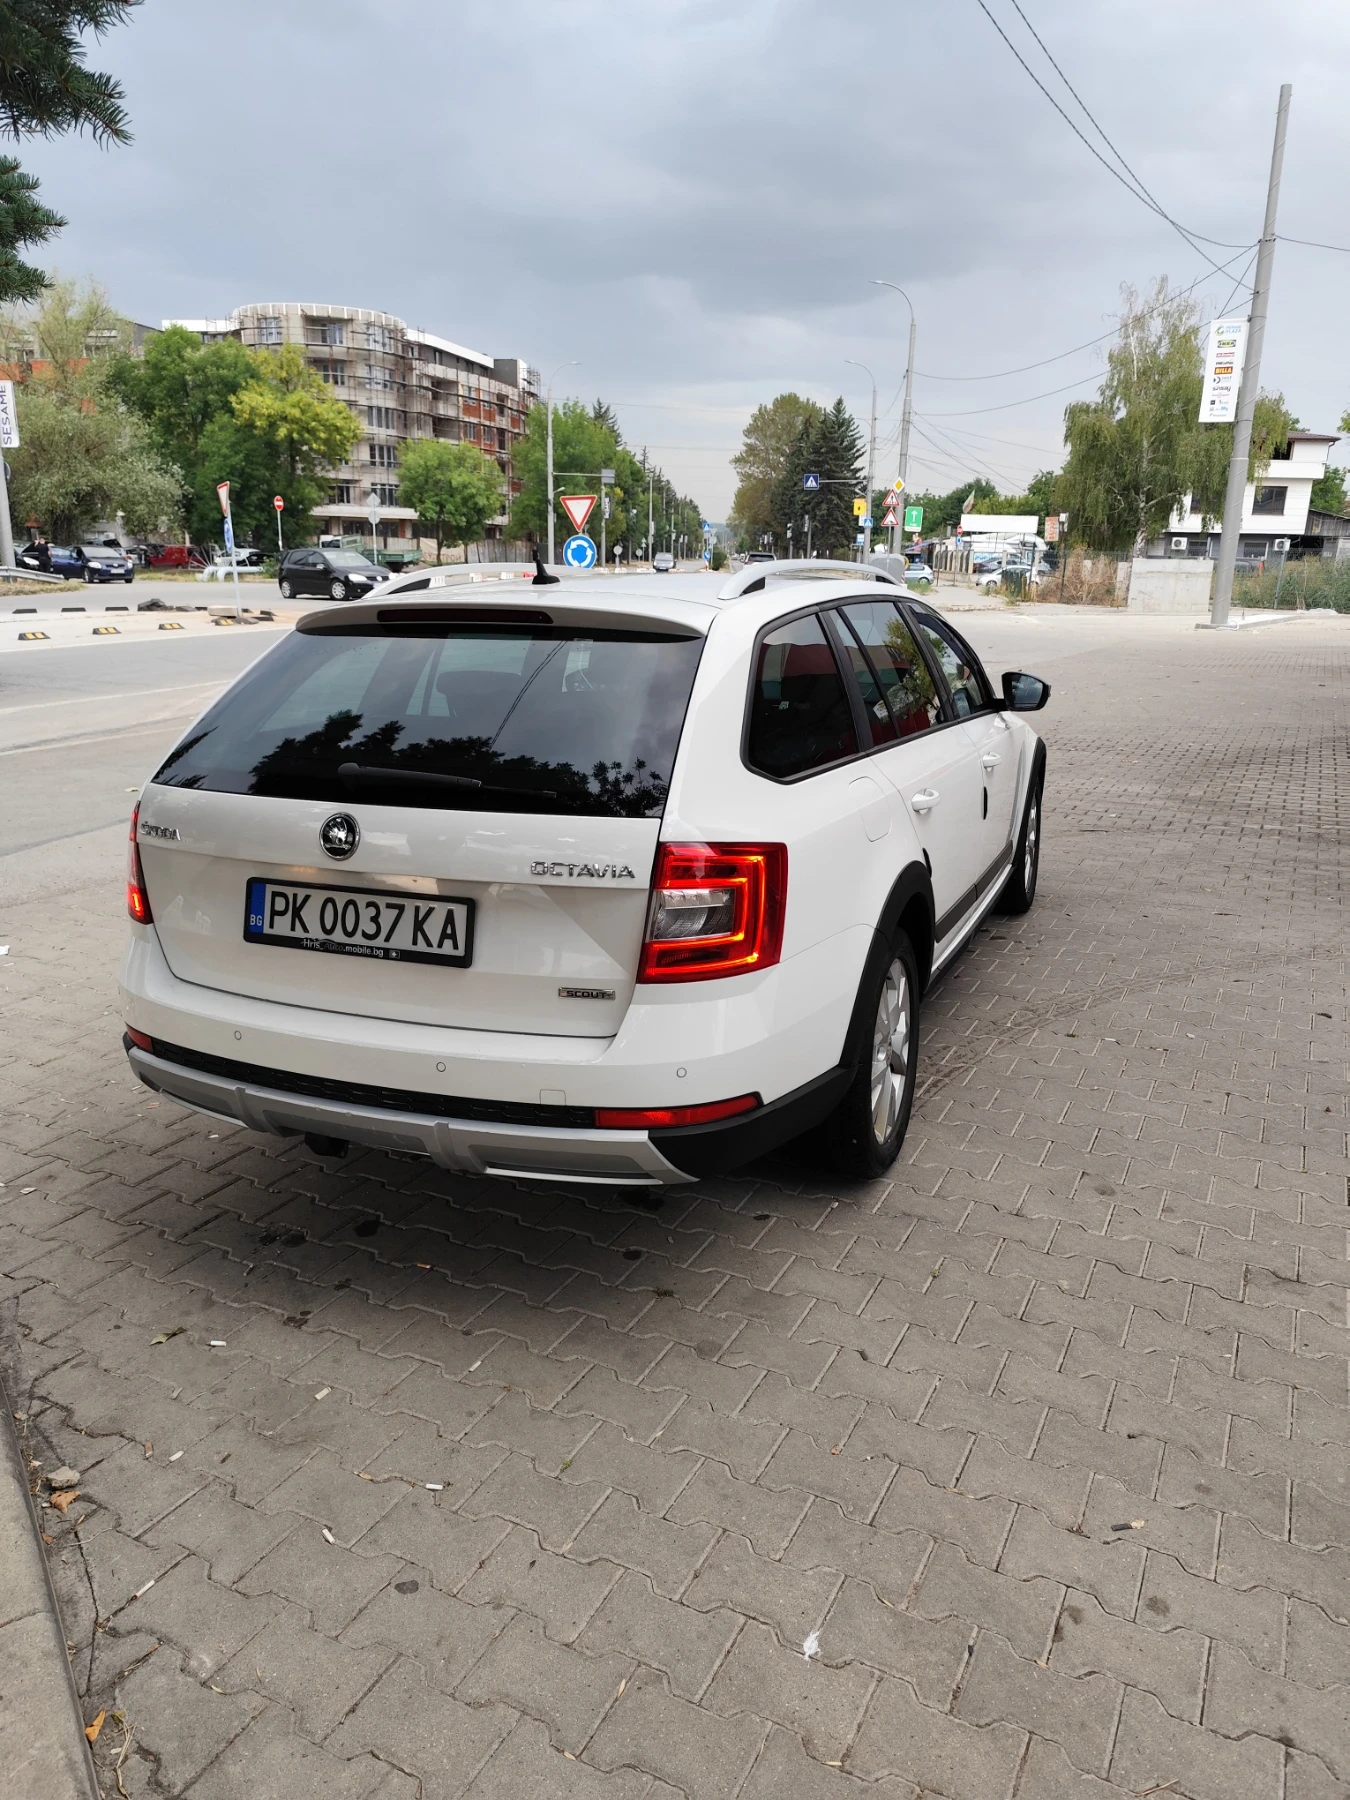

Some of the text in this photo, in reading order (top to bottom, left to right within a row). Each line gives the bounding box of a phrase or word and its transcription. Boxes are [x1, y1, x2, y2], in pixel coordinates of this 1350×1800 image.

[0, 384, 12, 445] SESAME
[530, 860, 636, 879] OCTAVIA
[249, 914, 263, 927] BG
[268, 890, 460, 951] PK 0037 KA
[565, 989, 608, 1000] SCOUT
